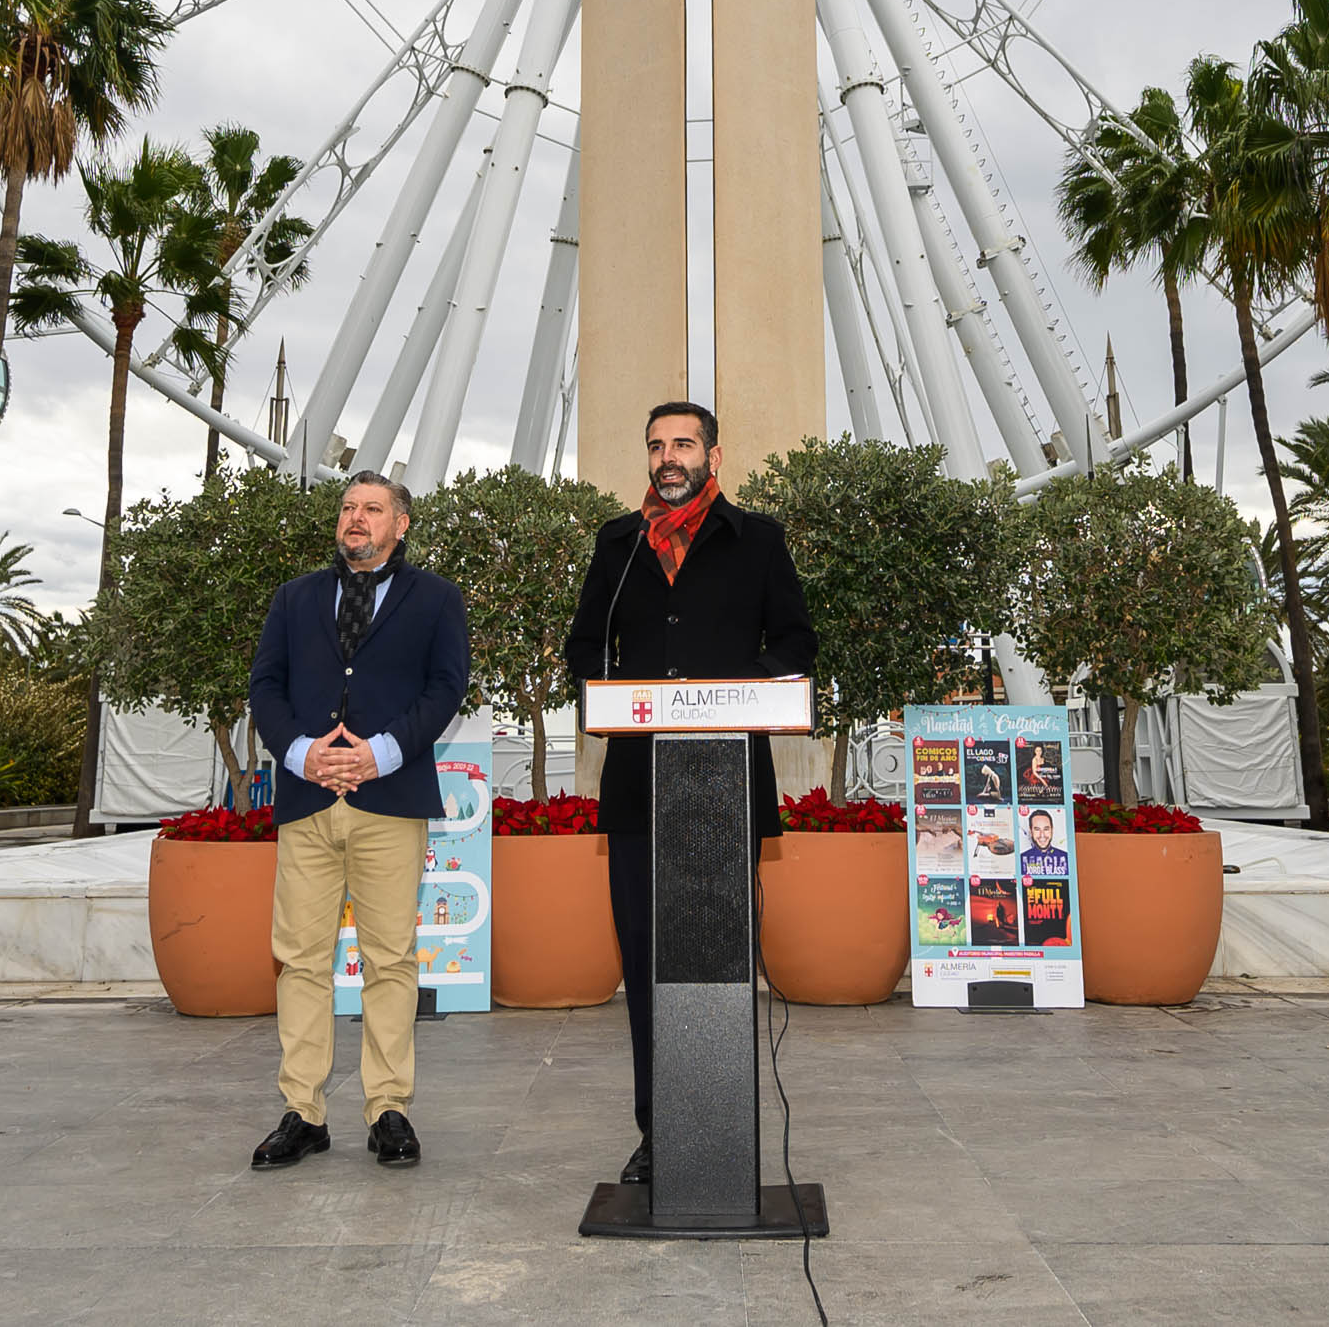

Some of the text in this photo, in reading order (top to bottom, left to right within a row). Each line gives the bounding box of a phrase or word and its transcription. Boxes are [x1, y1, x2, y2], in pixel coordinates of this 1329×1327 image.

[671, 685, 759, 706] ALMERÍA
[671, 709, 717, 720] CIUDAD
[921, 713, 1049, 737] Navidad Cultural
[1035, 888, 1063, 904] FULL
[1027, 904, 1064, 920] MONTY
[940, 962, 977, 971] ALMERÍA
